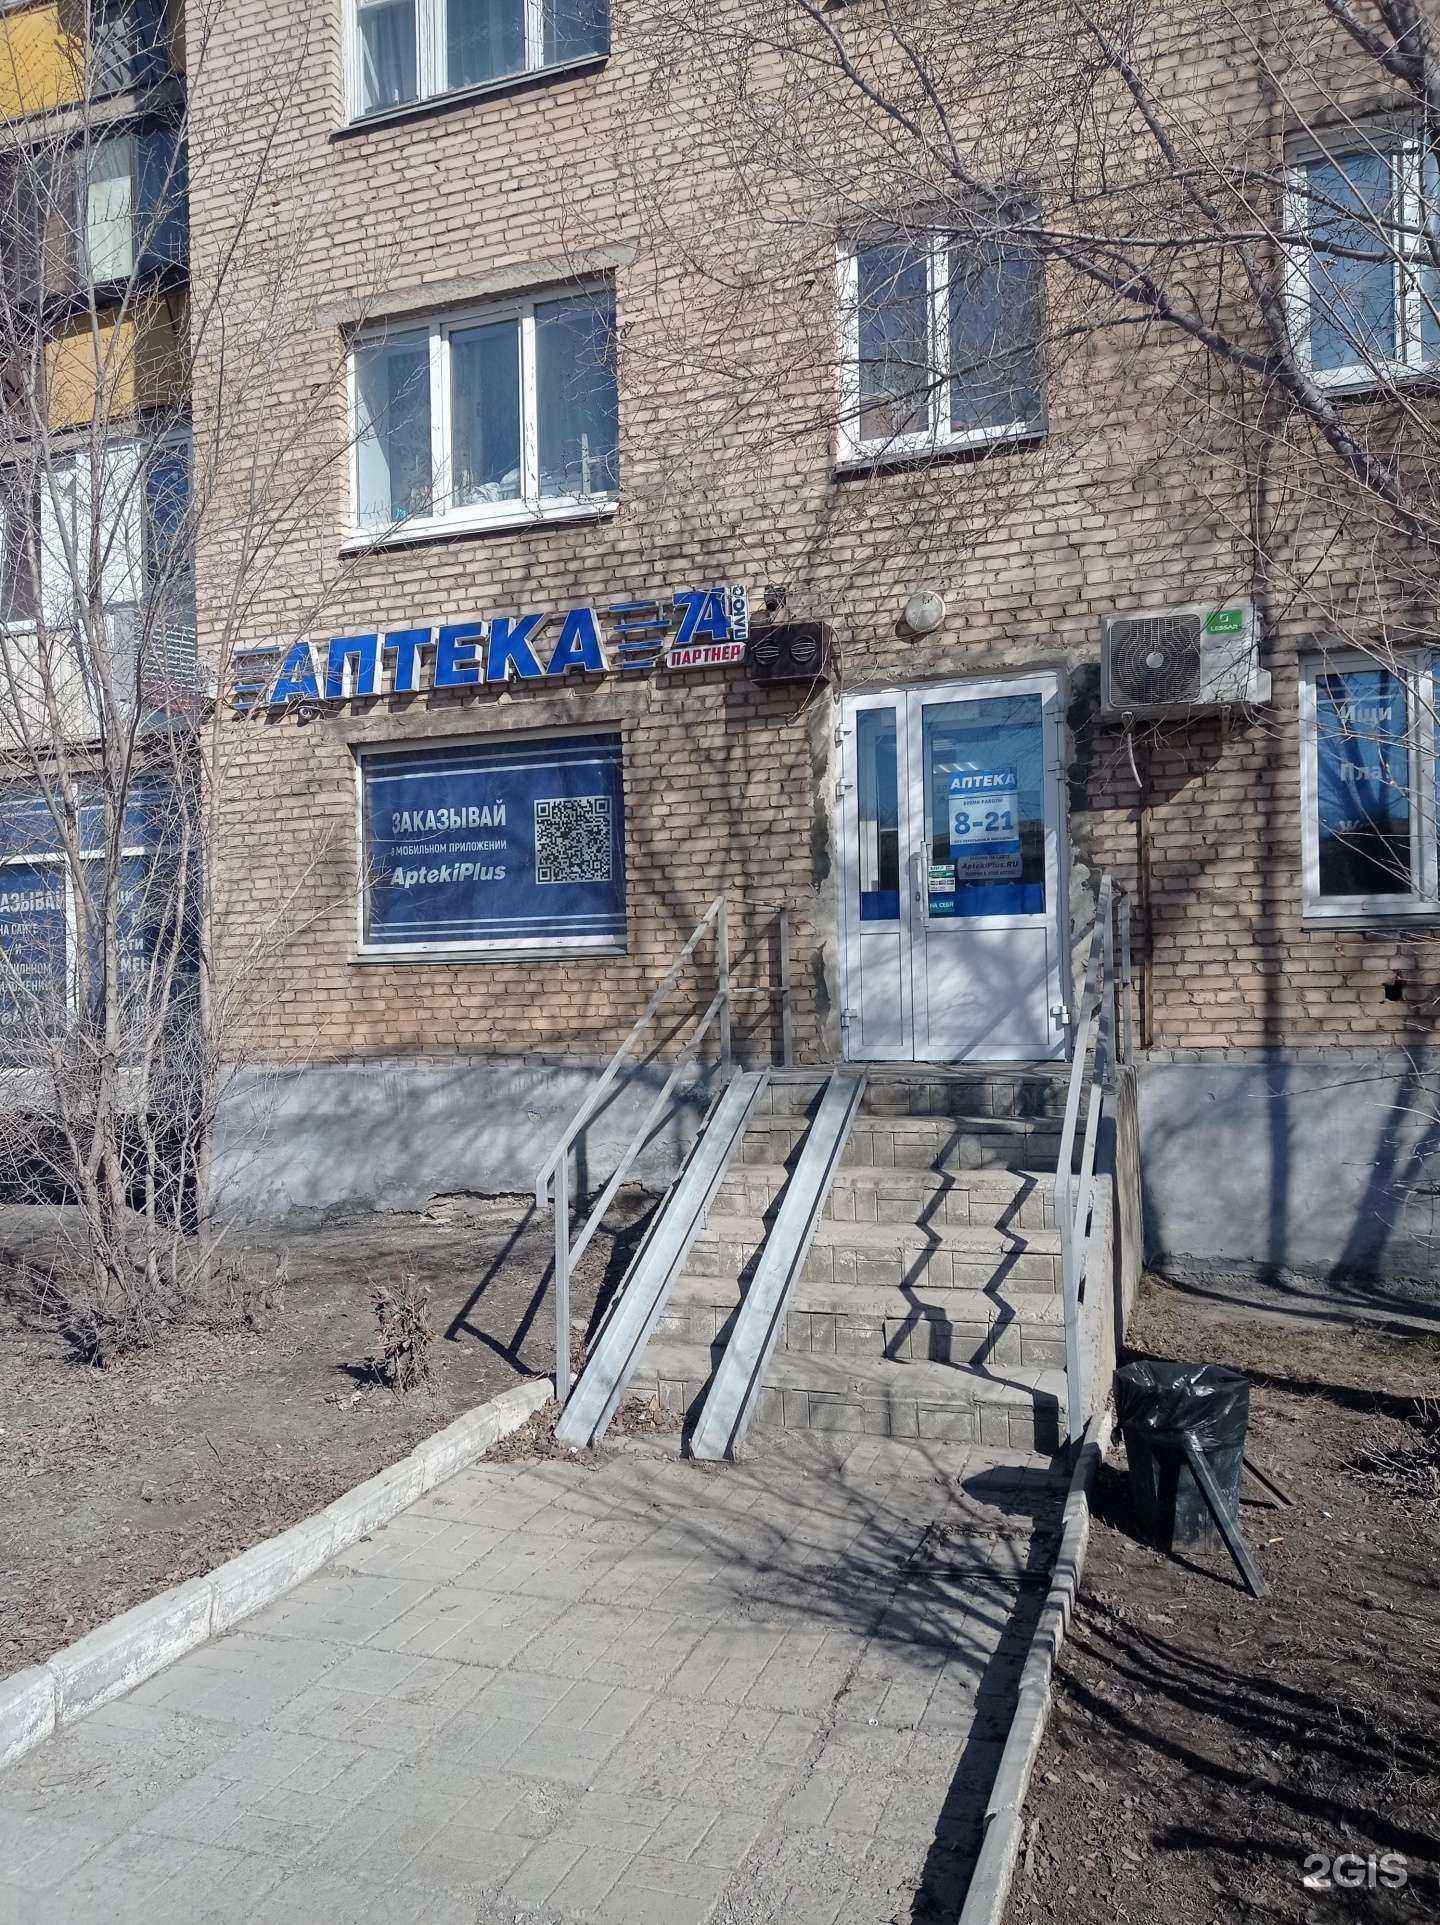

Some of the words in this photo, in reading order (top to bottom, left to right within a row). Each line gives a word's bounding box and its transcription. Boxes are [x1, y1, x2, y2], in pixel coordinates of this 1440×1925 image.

[731, 584, 748, 640] ПЛЮС
[268, 606, 610, 704] АПТЕКА
[671, 644, 741, 667] ПАРТНЕР
[950, 773, 1016, 789] АПТЕКА
[391, 800, 506, 834] ЗАКАЗЫВАЙ
[954, 810, 1014, 835] 8-21
[397, 841, 446, 856] МОБИЛЬНОМ
[449, 839, 507, 852] ПРИЛОЖЕНИИ
[391, 862, 506, 889] AptekiPlus
